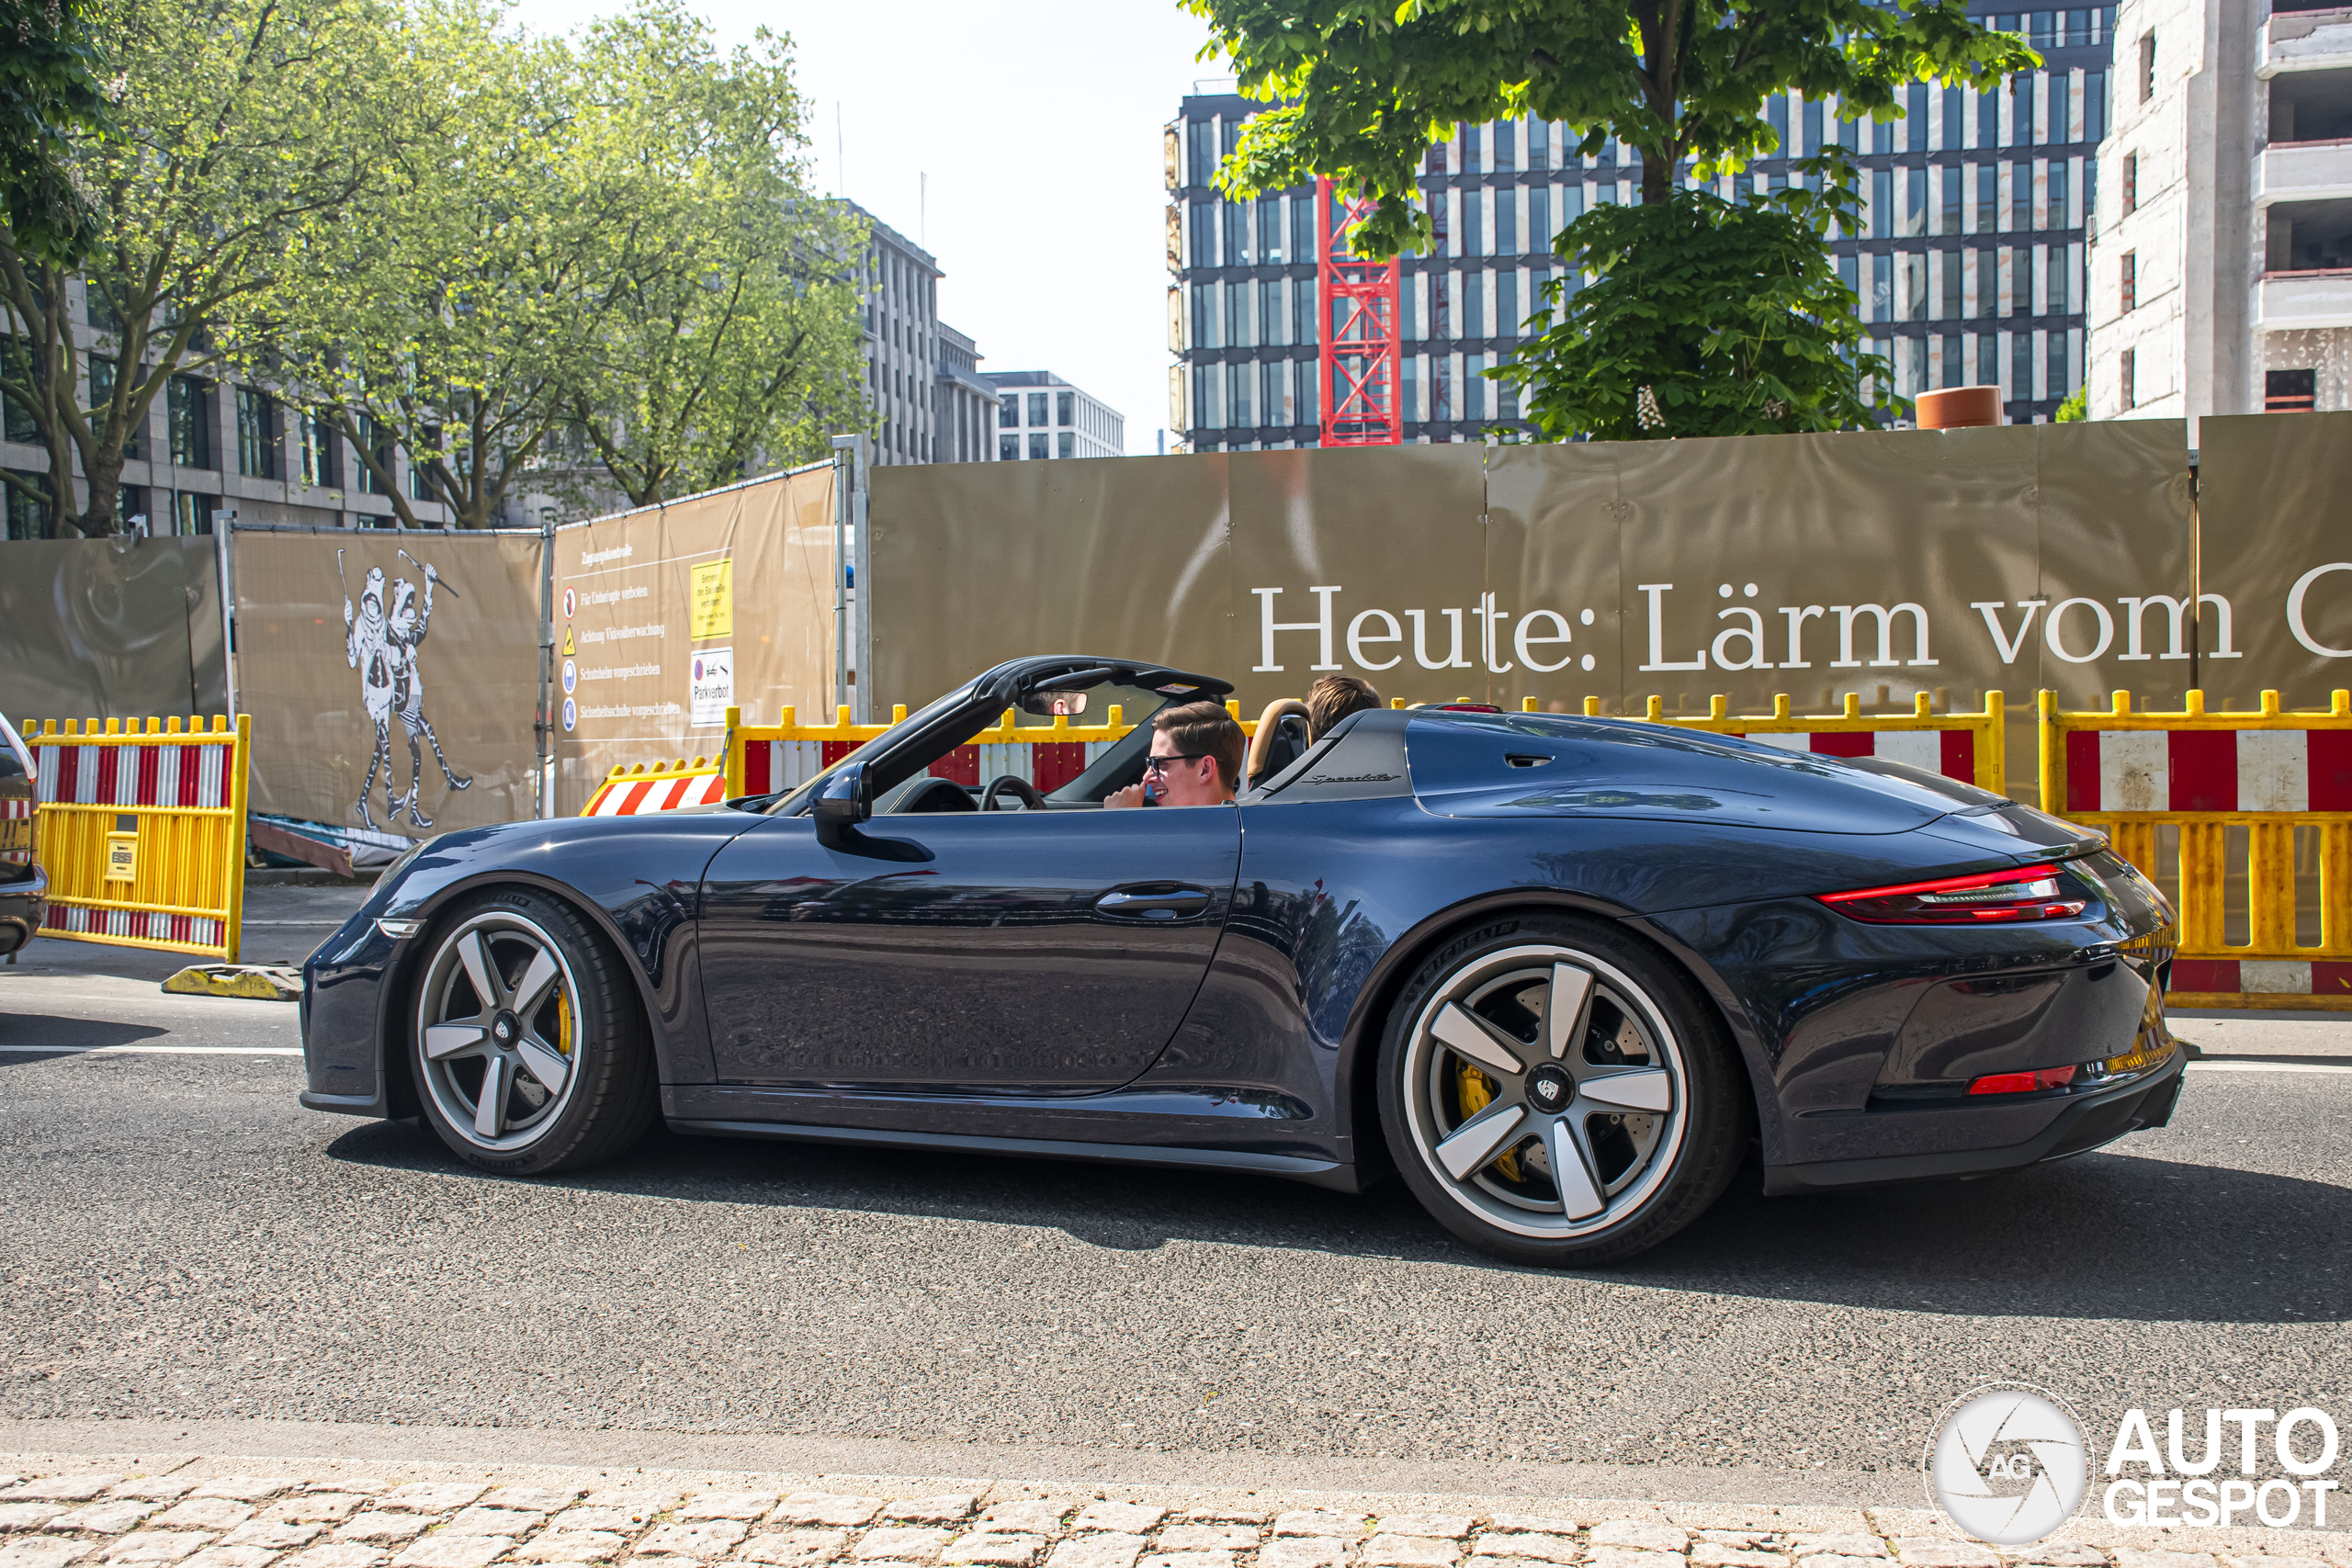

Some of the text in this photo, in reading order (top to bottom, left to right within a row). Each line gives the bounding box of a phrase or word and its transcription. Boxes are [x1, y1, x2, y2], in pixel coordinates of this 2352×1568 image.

[581, 592, 591, 606] Für
[621, 586, 648, 600] verboten
[580, 622, 665, 645] Achtung Videoüberwachung
[1250, 585, 1596, 673] Heute:
[1637, 582, 1940, 671] Lärm
[1970, 592, 2243, 664] vom
[580, 661, 662, 682] Schutzhelm vorgeschrieben
[694, 683, 729, 700] Parkverbot
[580, 701, 682, 720] Sicherheitsschuhe vorgeschrieben
[1301, 773, 1403, 785] Speedster
[1422, 921, 1514, 983] MICHELIN
